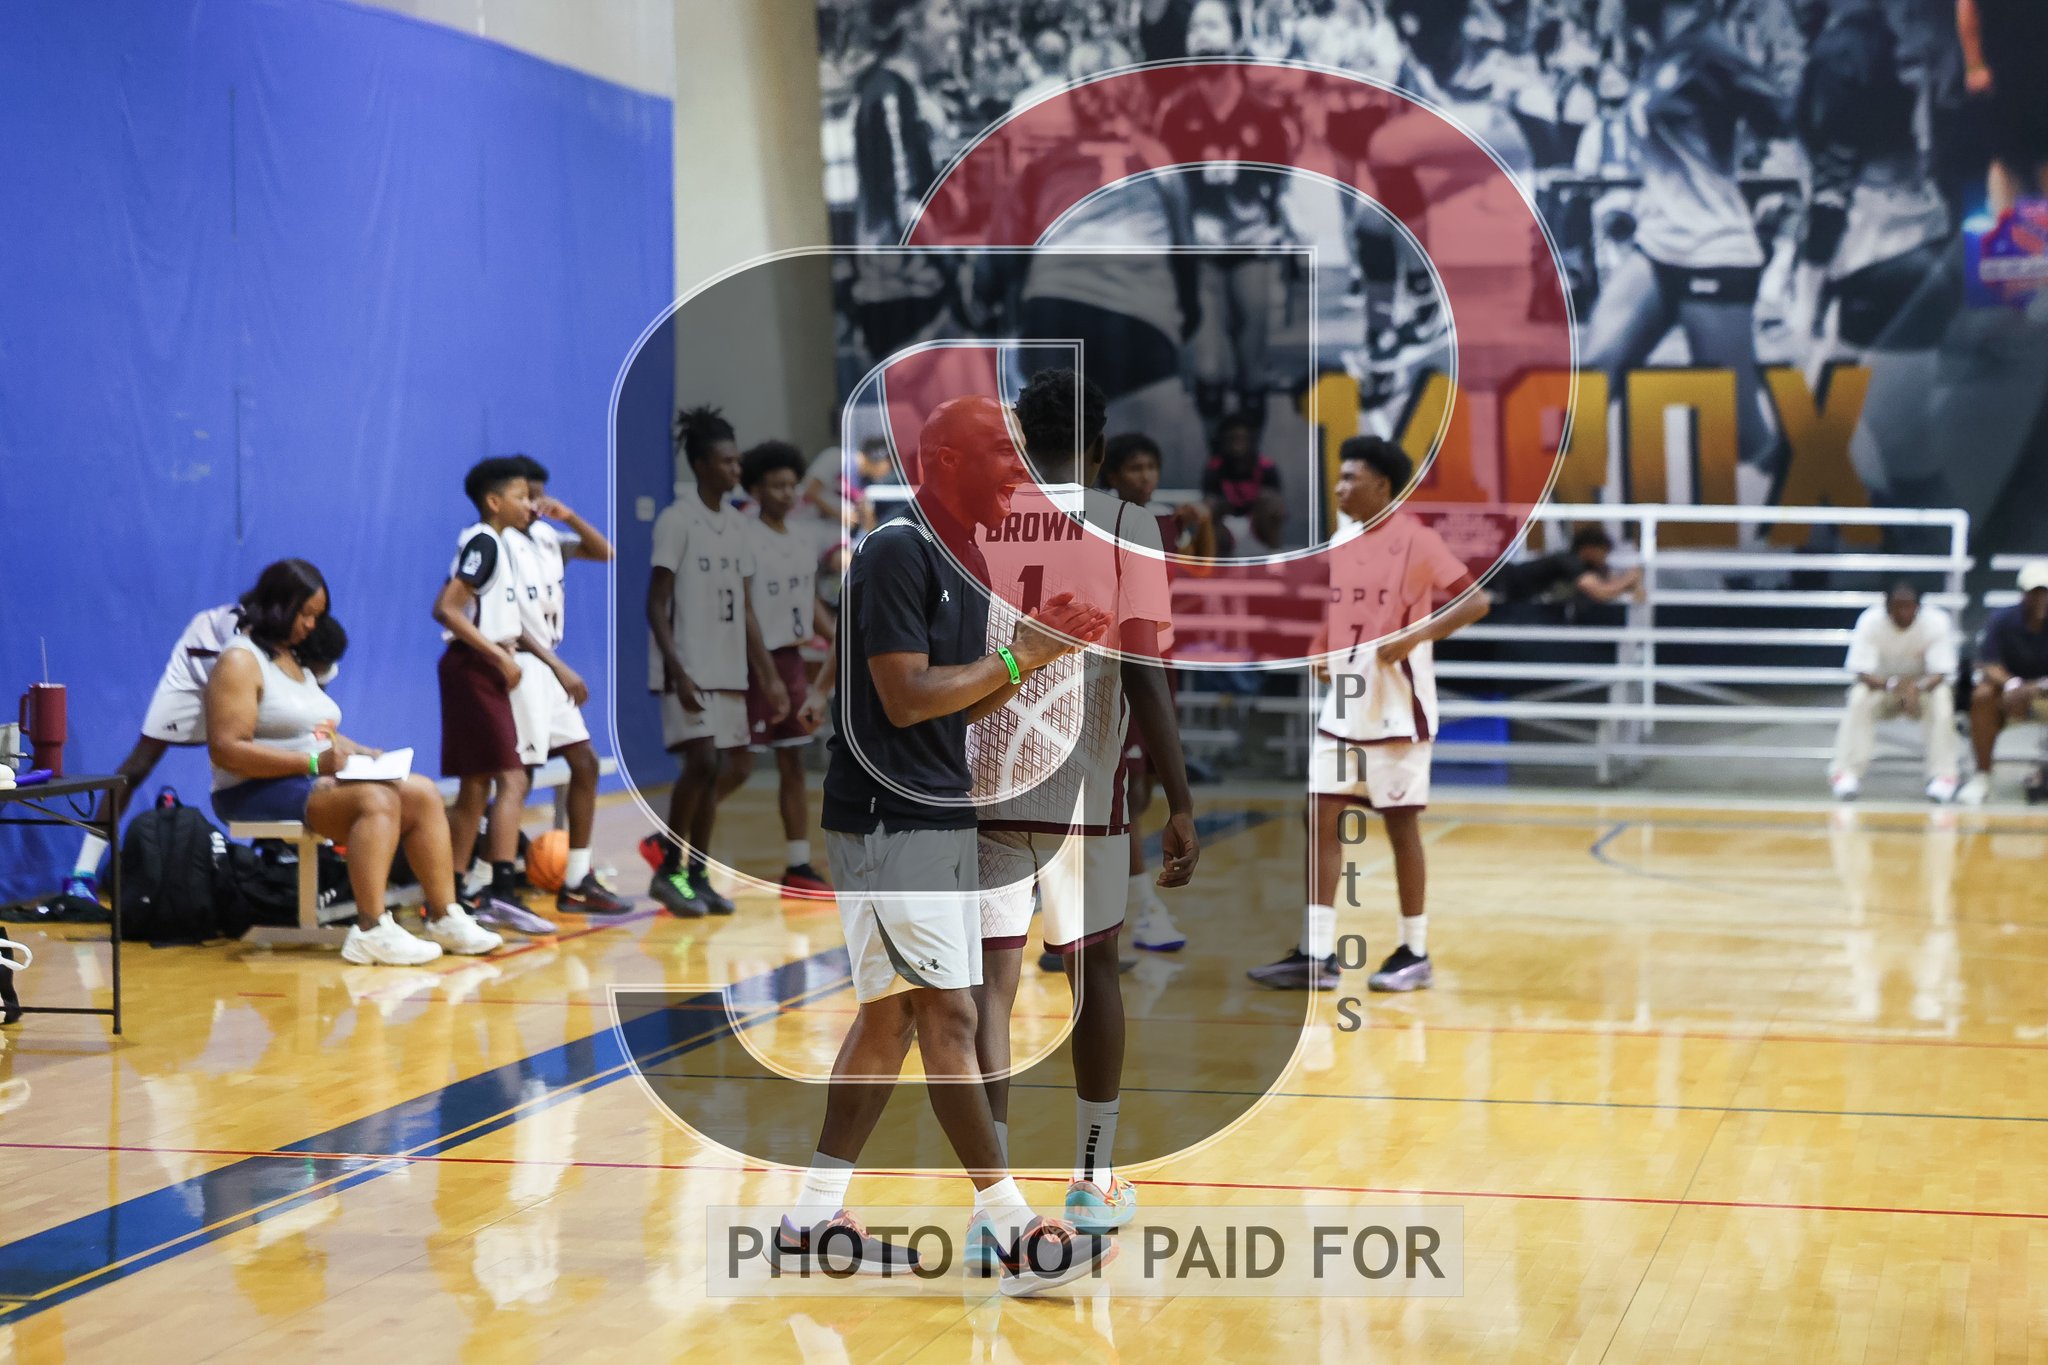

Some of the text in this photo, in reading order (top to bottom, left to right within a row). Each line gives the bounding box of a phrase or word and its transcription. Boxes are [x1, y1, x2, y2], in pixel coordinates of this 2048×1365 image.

[985, 510, 1087, 542] BROWN
[1017, 565, 1044, 618] 1
[1348, 623, 1364, 664] 7
